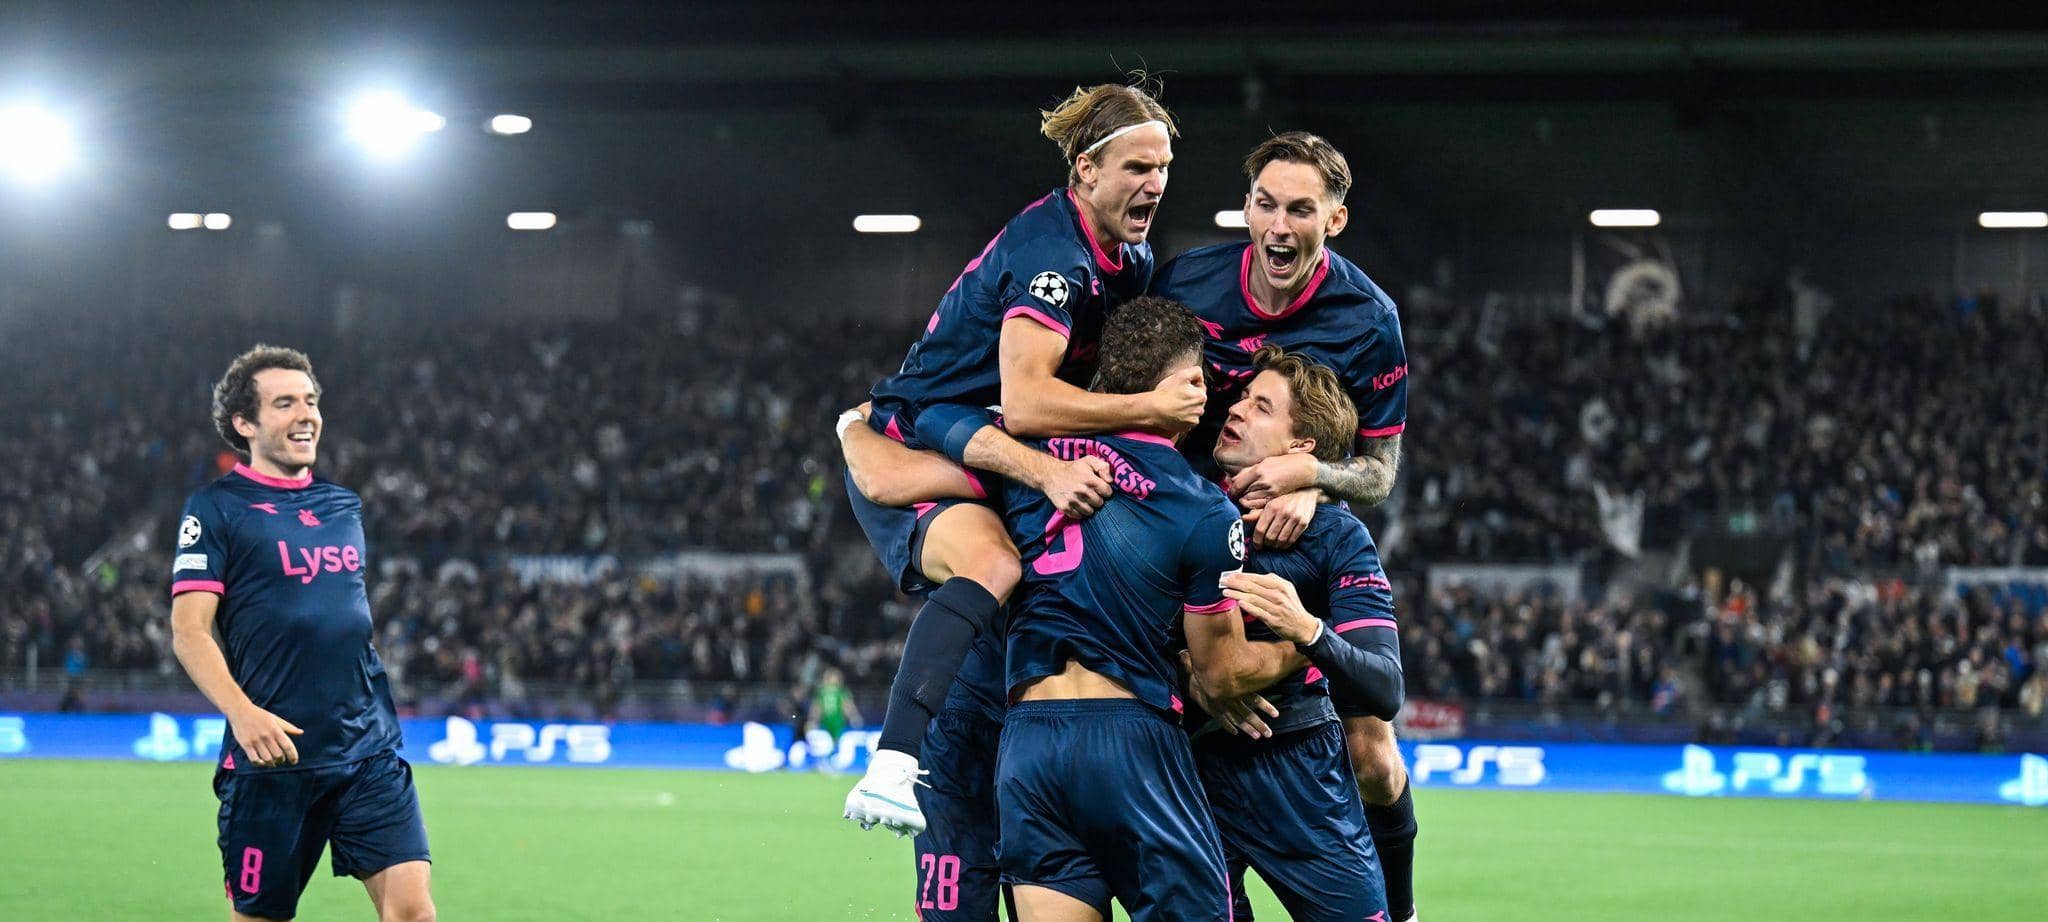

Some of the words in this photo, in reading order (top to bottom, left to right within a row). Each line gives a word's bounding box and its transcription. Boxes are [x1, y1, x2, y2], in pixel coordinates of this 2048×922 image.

[278, 541, 361, 584] Lyse
[490, 722, 612, 763] PS5
[1413, 744, 1546, 786] PS5
[1733, 752, 1867, 795] PS5
[240, 847, 263, 894] 8
[921, 853, 961, 911] 28
